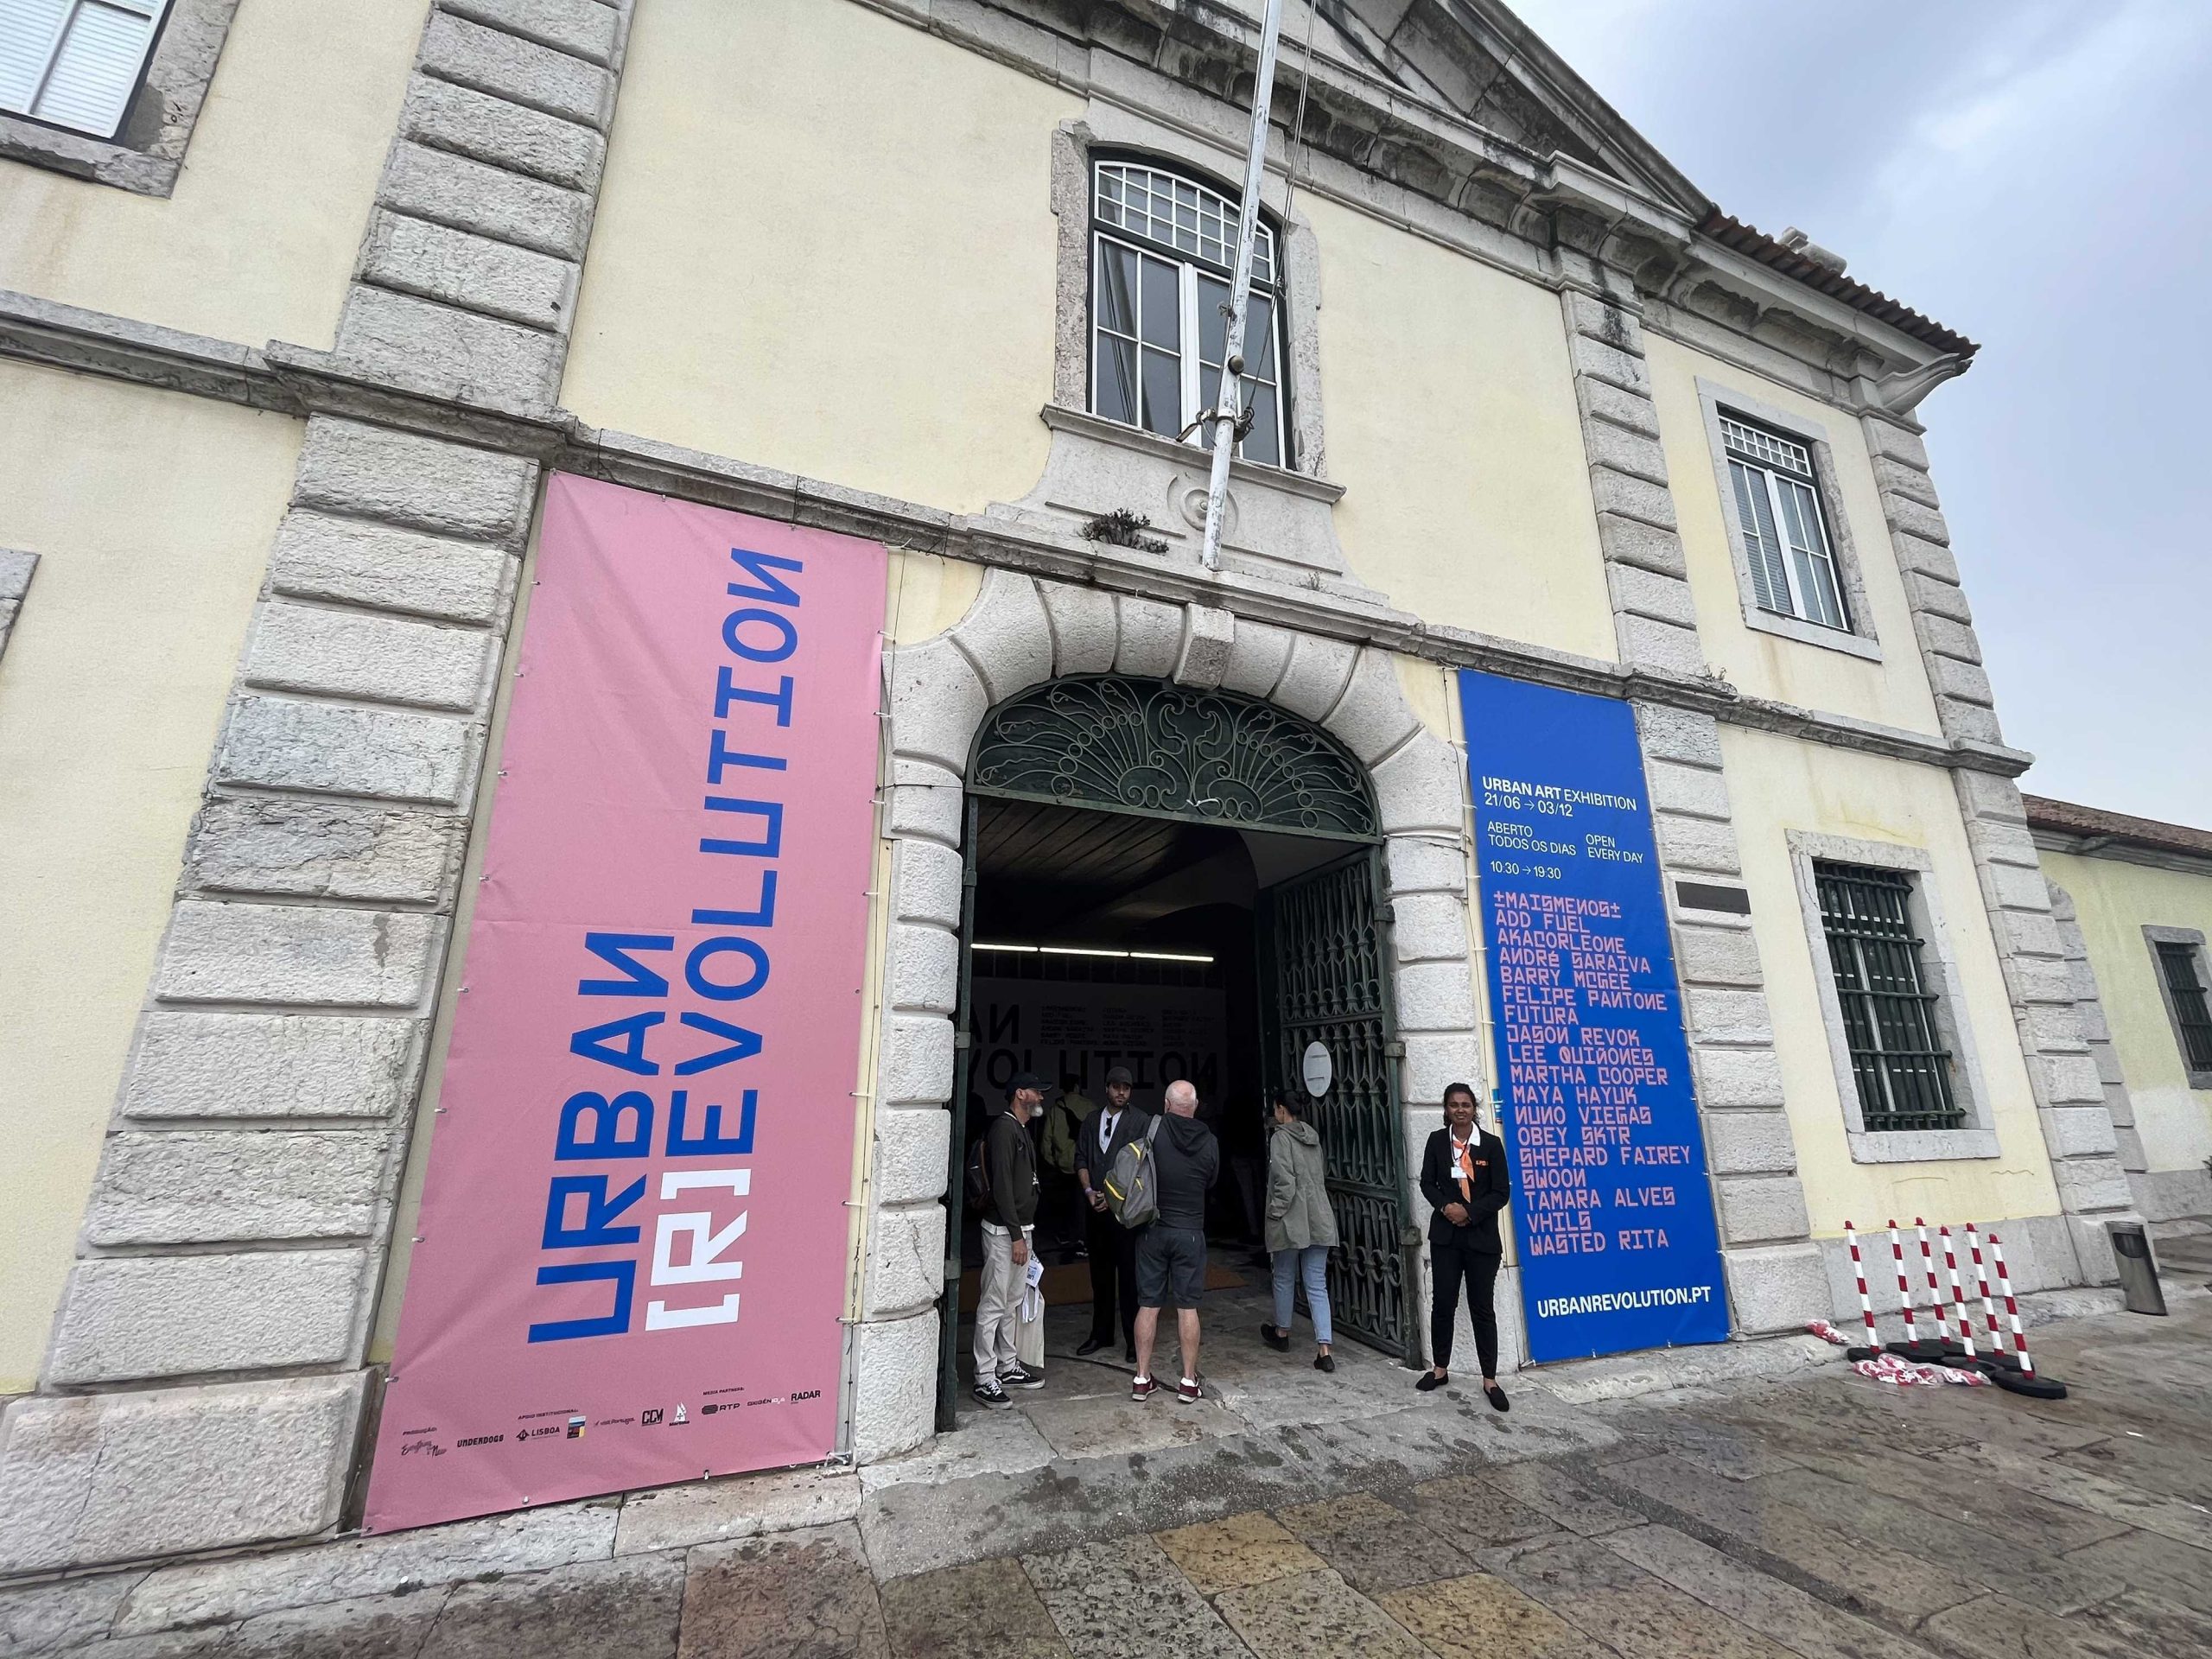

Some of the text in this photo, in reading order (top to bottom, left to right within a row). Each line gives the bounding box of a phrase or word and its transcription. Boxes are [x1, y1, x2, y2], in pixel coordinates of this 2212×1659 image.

[1482, 776, 1637, 811] URBAN ART EXHIBITION
[1484, 791, 1573, 817] 21/06 03/12
[1487, 821, 1533, 837] ABERTO
[1488, 834, 1577, 856] TODOS OS DIAS
[1586, 833, 1616, 848] OPEN
[1587, 848, 1643, 864] EVERY DAY
[1491, 861, 1561, 880] 10:30 19:30
[1496, 909, 1590, 933] ADD FUEL
[1497, 928, 1626, 954] AKACORLEONE
[1571, 951, 1651, 974] SARAIVA
[1500, 966, 1631, 991] BARRY MCGEE
[1502, 985, 1668, 1011] FELIPE PANTONE
[1504, 1005, 1579, 1025] FUTURA
[1505, 1025, 1640, 1046] JASON REVOK
[1508, 1045, 1547, 1064] LEE
[1510, 1065, 1669, 1085] MARTHA COOPER
[1512, 1085, 1637, 1105] MAYA HAYUK
[1515, 1106, 1652, 1125] NUNO VIEGAS
[527, 931, 675, 1344] URBAN
[1518, 1127, 1630, 1146] OBEY SKTR
[1519, 1145, 1691, 1167] SHEPARD FAIREY
[1522, 1168, 1586, 1190] SWOON
[1524, 1186, 1675, 1211] TAMARA ALVES
[1527, 1211, 1592, 1233] VHILS
[1529, 1229, 1669, 1256] WASTED RITA
[1537, 1286, 1712, 1319] URBANREVOLUTION.PT
[791, 1389, 821, 1402] RADAR
[457, 1434, 505, 1447] UNDERDOGS
[531, 1427, 560, 1437] LISBOA
